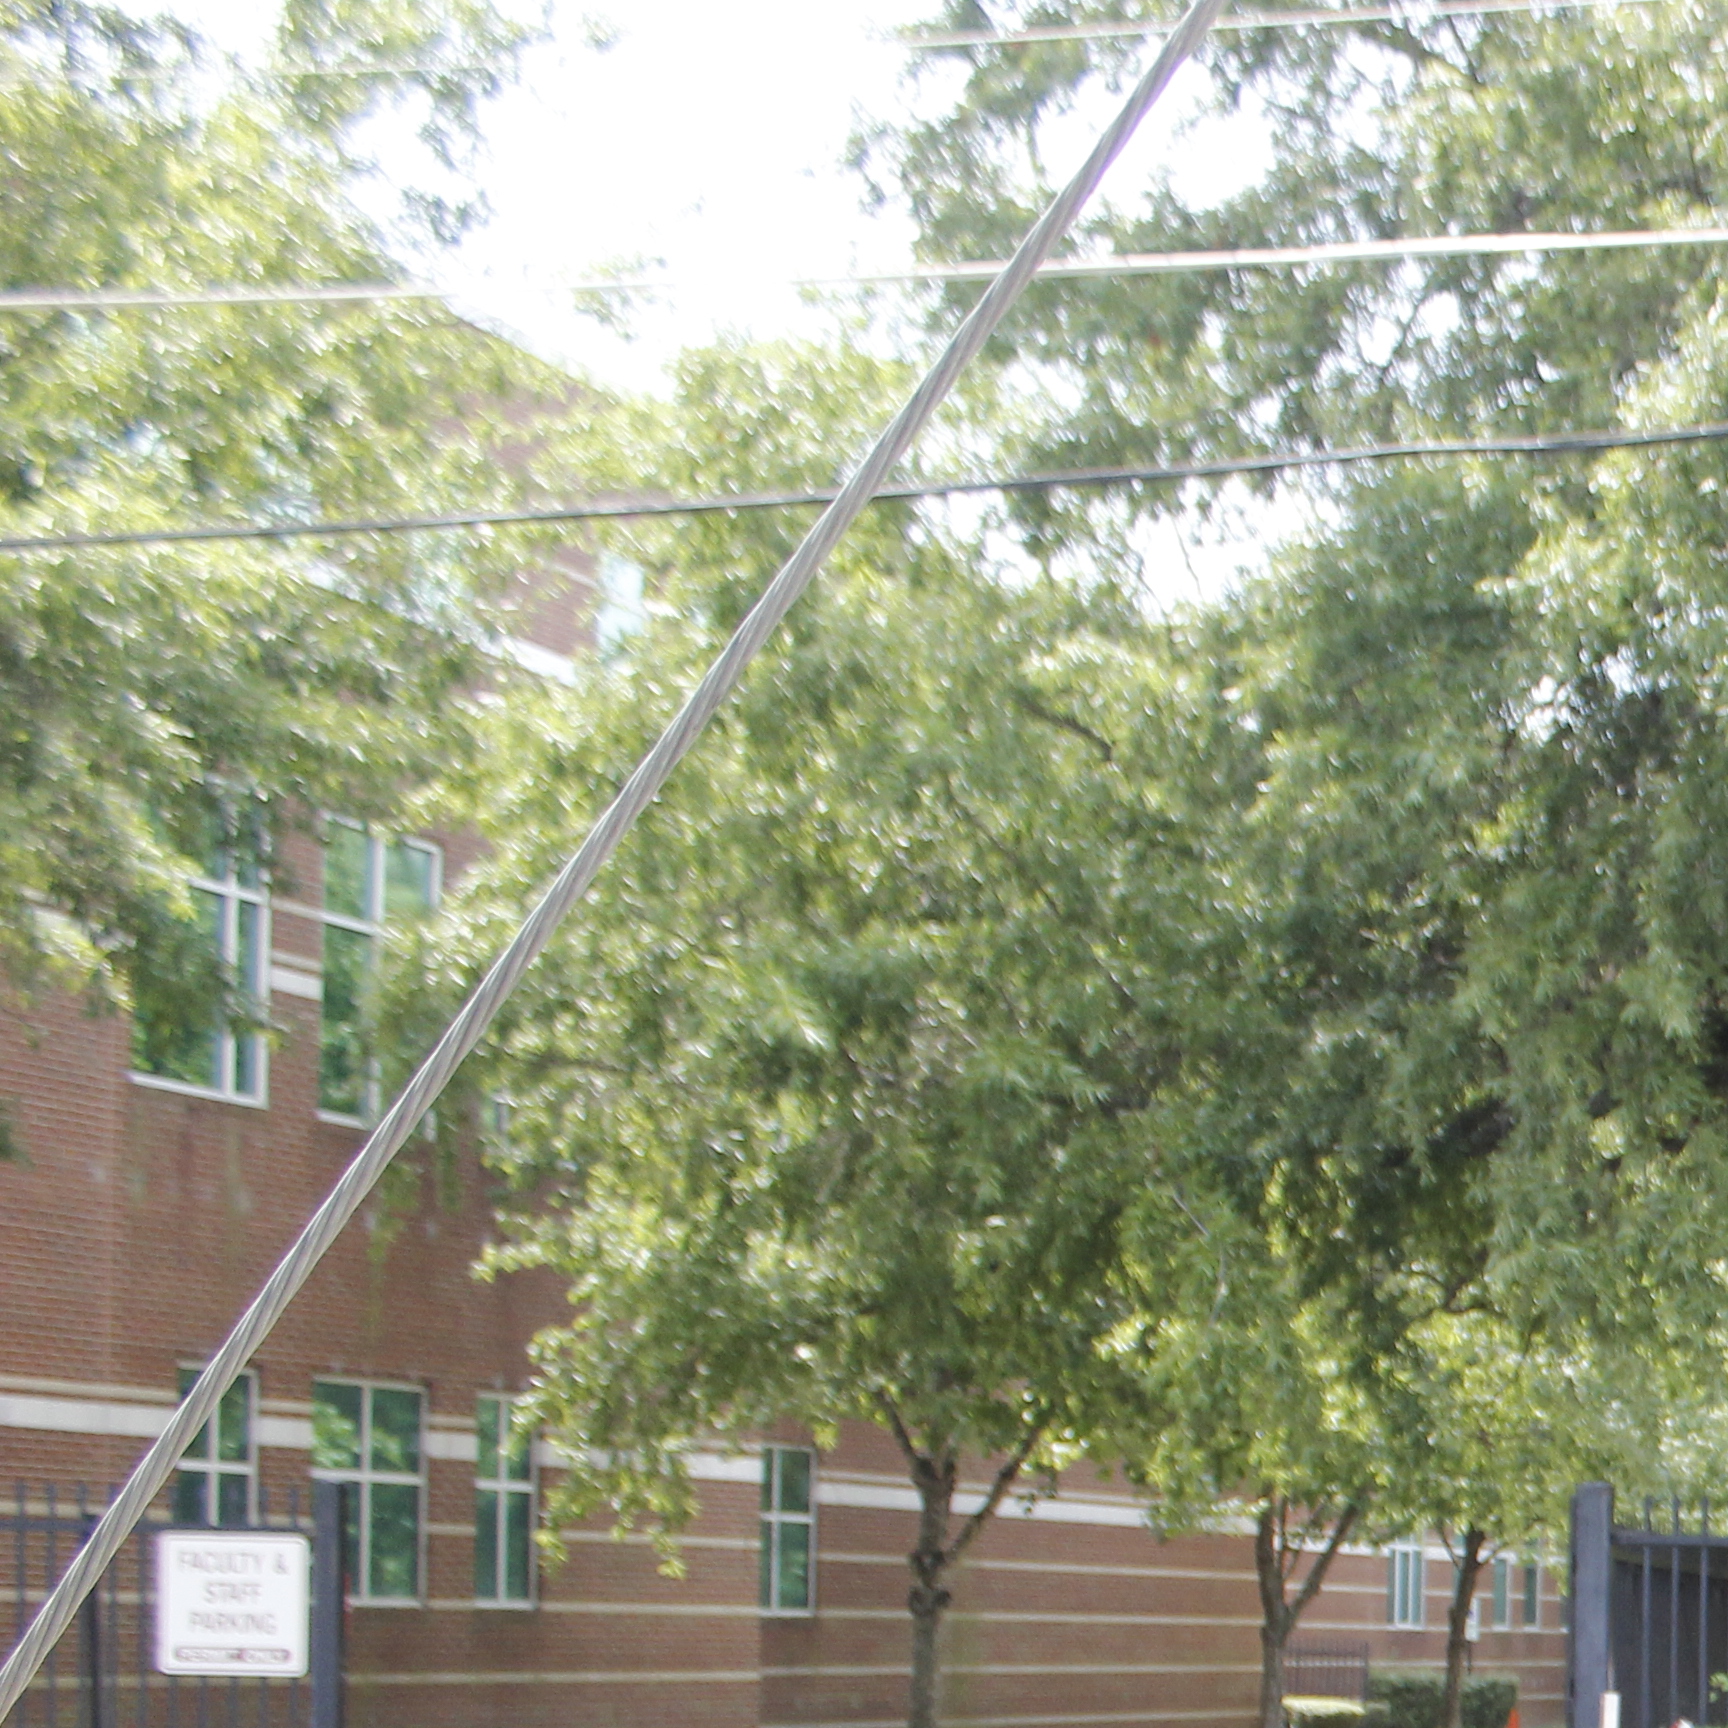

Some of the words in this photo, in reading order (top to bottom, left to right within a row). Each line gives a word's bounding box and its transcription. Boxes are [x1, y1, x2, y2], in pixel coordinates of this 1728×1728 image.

[178, 1551, 265, 1575] FACULTY
[272, 1552, 289, 1575] &
[203, 1581, 263, 1604] STAFF
[188, 1611, 278, 1636] PARKING
